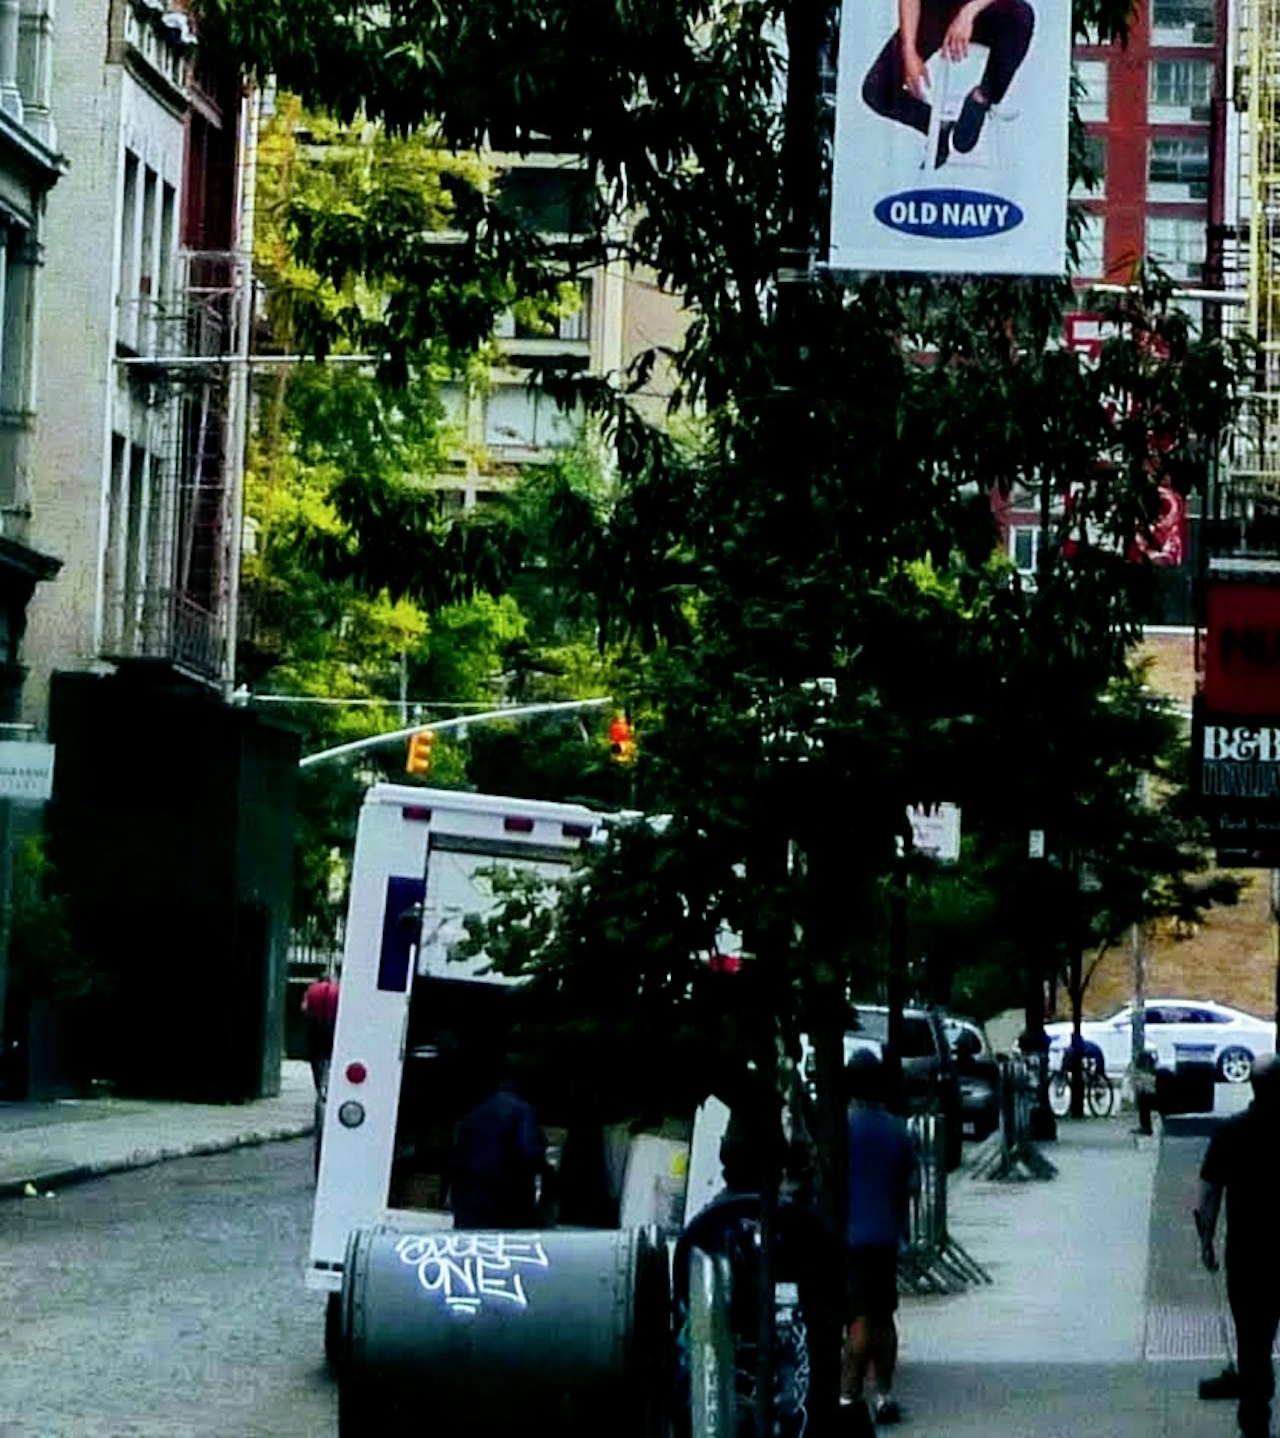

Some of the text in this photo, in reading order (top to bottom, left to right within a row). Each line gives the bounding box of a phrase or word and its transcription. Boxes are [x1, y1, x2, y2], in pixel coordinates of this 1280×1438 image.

[890, 201, 1009, 227] OLD NAVY
[418, 1257, 527, 1306] ONE
